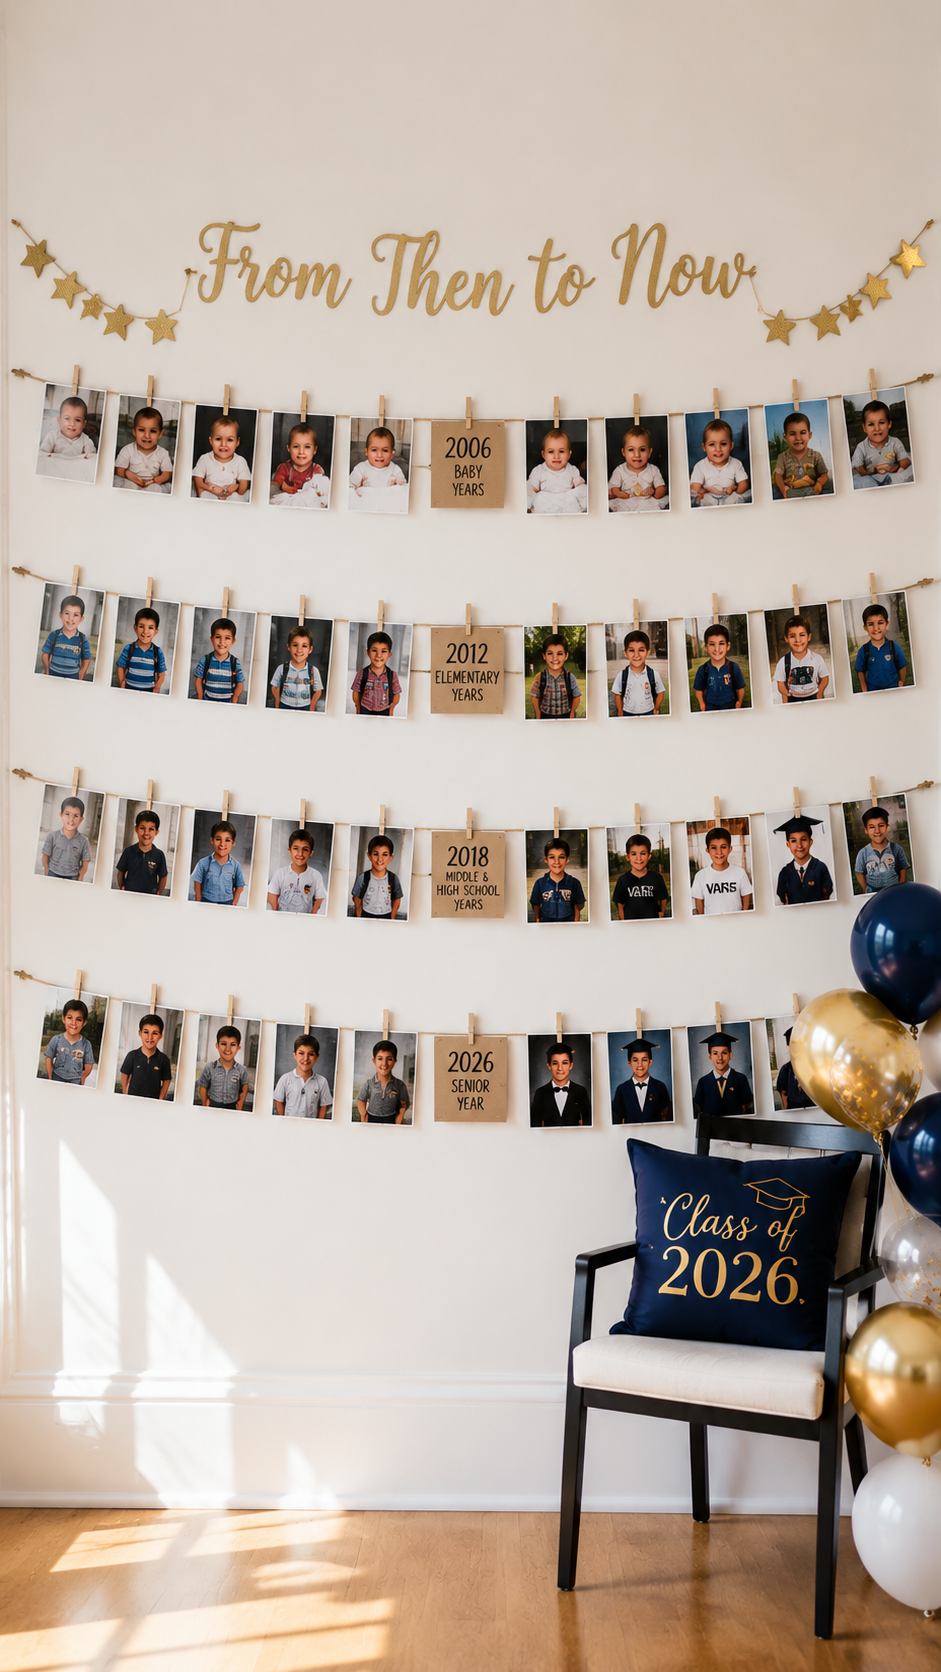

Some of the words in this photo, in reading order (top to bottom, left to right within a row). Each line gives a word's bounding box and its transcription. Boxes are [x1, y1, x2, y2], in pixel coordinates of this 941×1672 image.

[197, 221, 352, 309] From
[371, 230, 515, 317] Then
[527, 237, 596, 314] to
[611, 222, 755, 309] Now
[444, 436, 492, 459] 2006
[454, 464, 483, 479] BABY
[452, 482, 485, 497] YEARS
[445, 642, 489, 664] 2012
[435, 670, 501, 685] ELEMENTARY
[451, 687, 484, 702] YEARS
[446, 845, 489, 868] 2018
[445, 871, 479, 883] MIDDLE
[482, 871, 489, 883] &
[436, 884, 460, 896] HIGH
[463, 884, 501, 897] SCHOOL
[453, 898, 484, 912] YEARS
[447, 1050, 495, 1073] 2026
[451, 1078, 491, 1094] SENIOR
[456, 1096, 485, 1111] YEAR
[663, 1192, 758, 1242] Class
[767, 1205, 804, 1253] of
[657, 1245, 799, 1306] 2026
